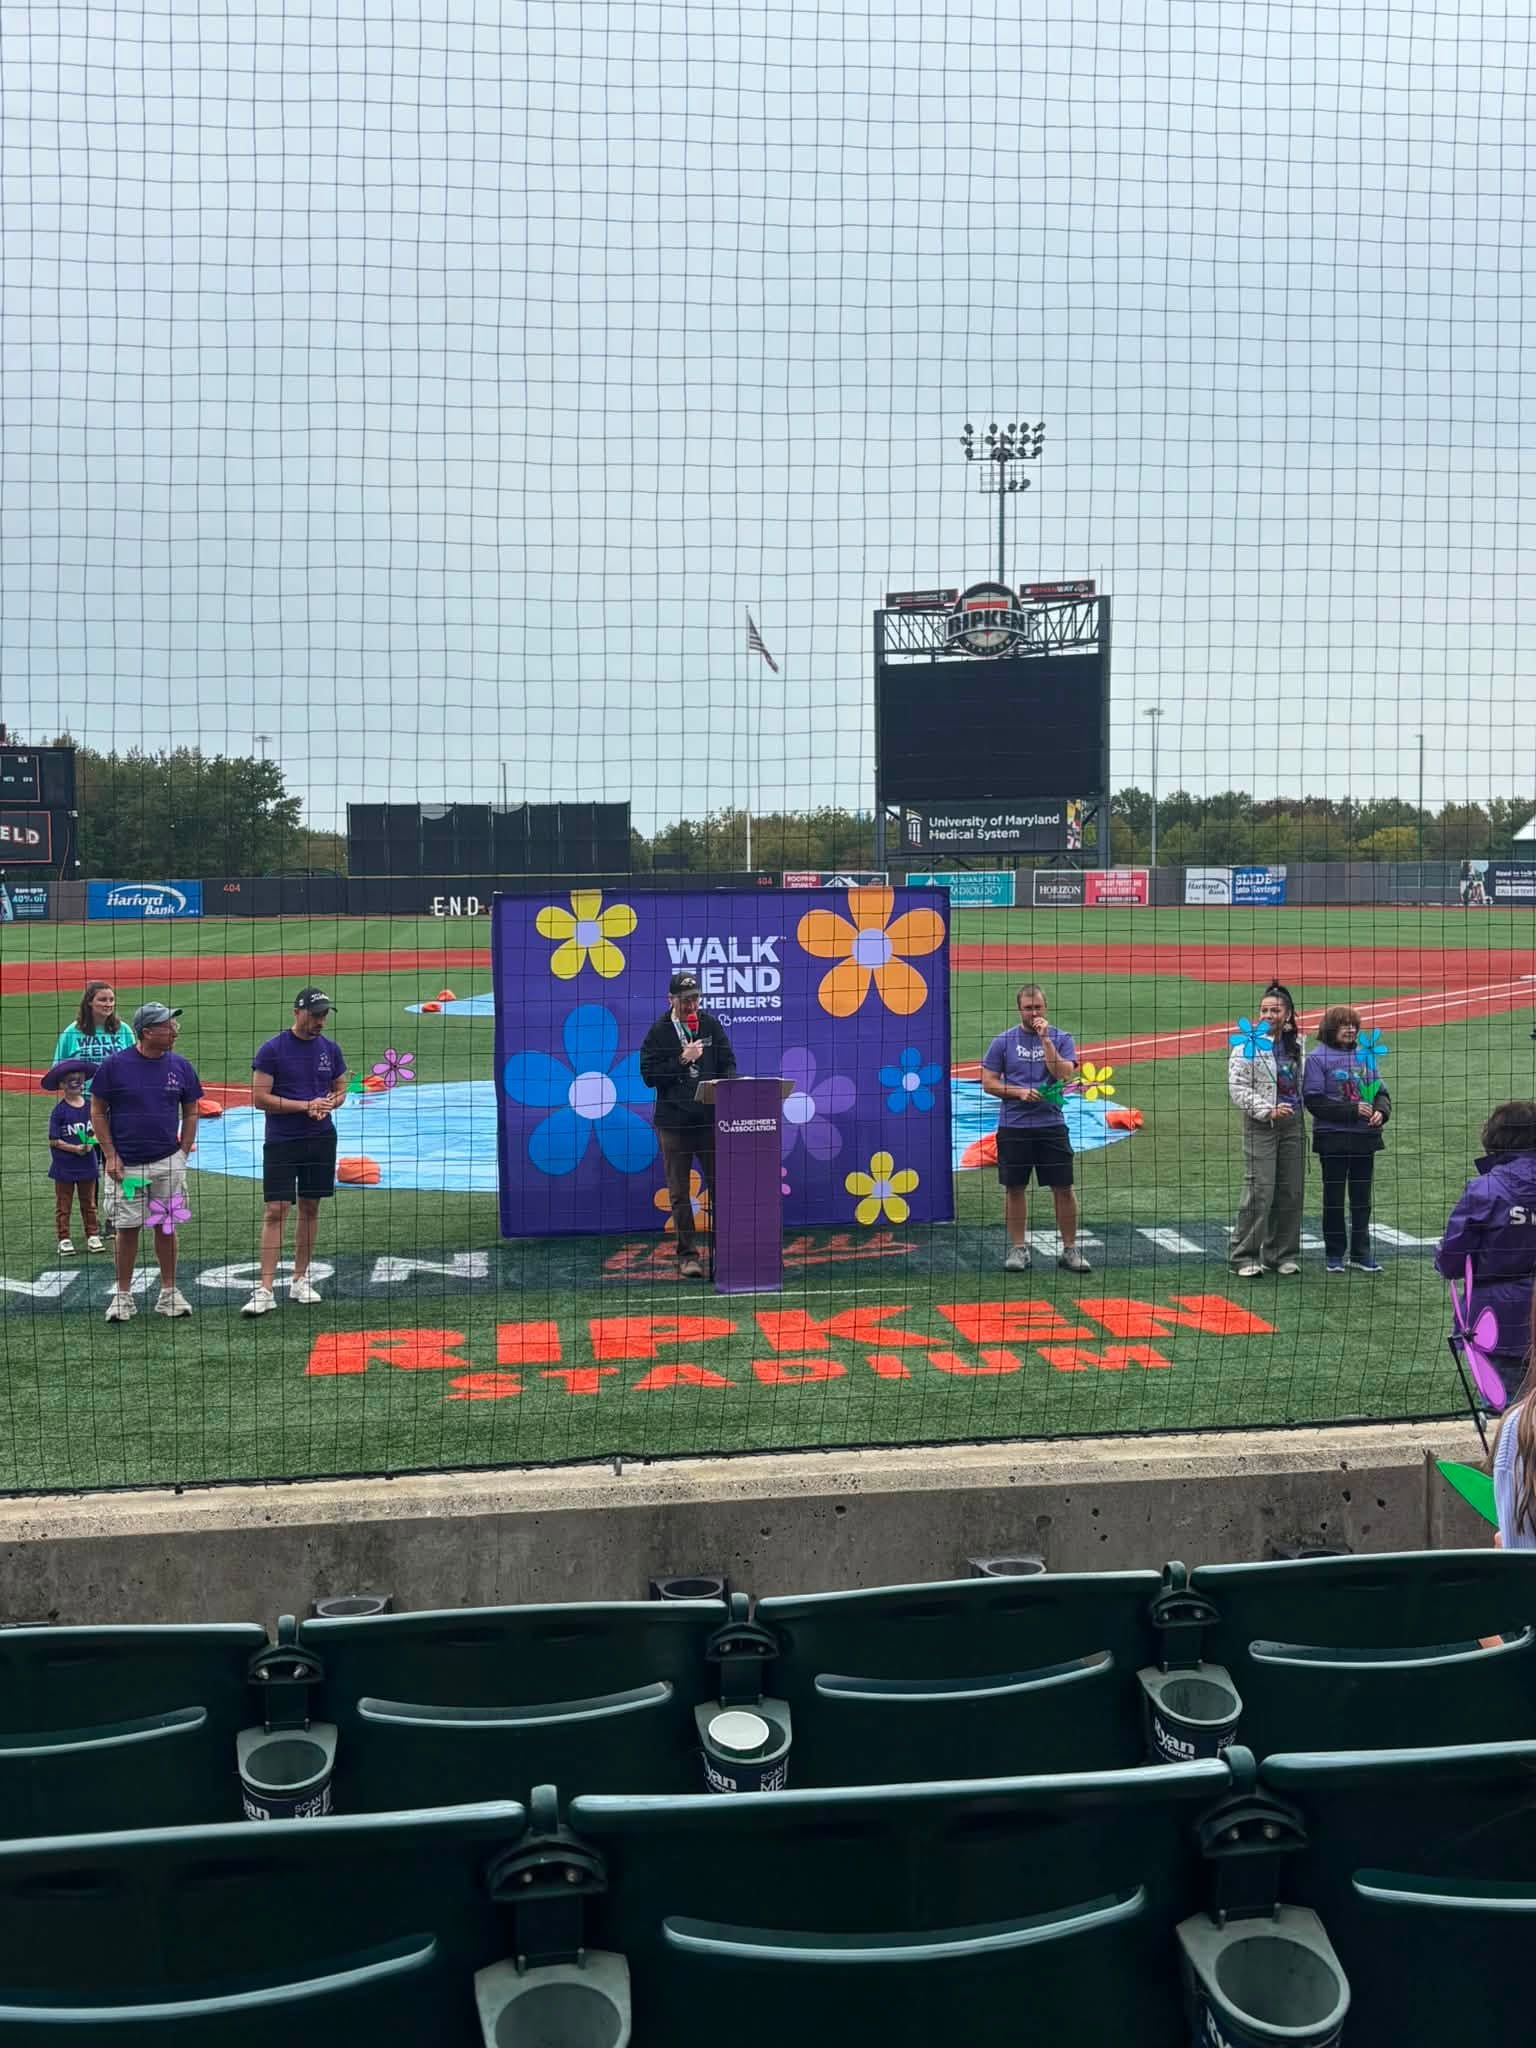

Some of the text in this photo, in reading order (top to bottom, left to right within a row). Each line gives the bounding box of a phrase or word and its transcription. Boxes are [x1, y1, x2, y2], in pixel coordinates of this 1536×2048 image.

[949, 606, 1027, 636] RIPKEN
[929, 812, 1060, 829] University of Maryland
[929, 828, 1020, 841] Medical System
[1235, 873, 1273, 886] SLIDE
[224, 884, 240, 893] 404
[1039, 885, 1081, 895] HORIZON
[107, 894, 164, 906] Harford
[434, 896, 479, 917] END
[145, 904, 175, 915] Bank
[666, 936, 780, 964] WALK
[701, 966, 781, 994] END
[733, 1015, 782, 1023] ASSOCIATION
[77, 1035, 121, 1048] WALK
[732, 1118, 776, 1126] ALZHEIMER'S
[730, 1125, 776, 1133] ASSOCIATION
[305, 1295, 1279, 1375] RIPKEN
[446, 1344, 1174, 1400] STADIUM
[761, 1763, 784, 1782] SCAN
